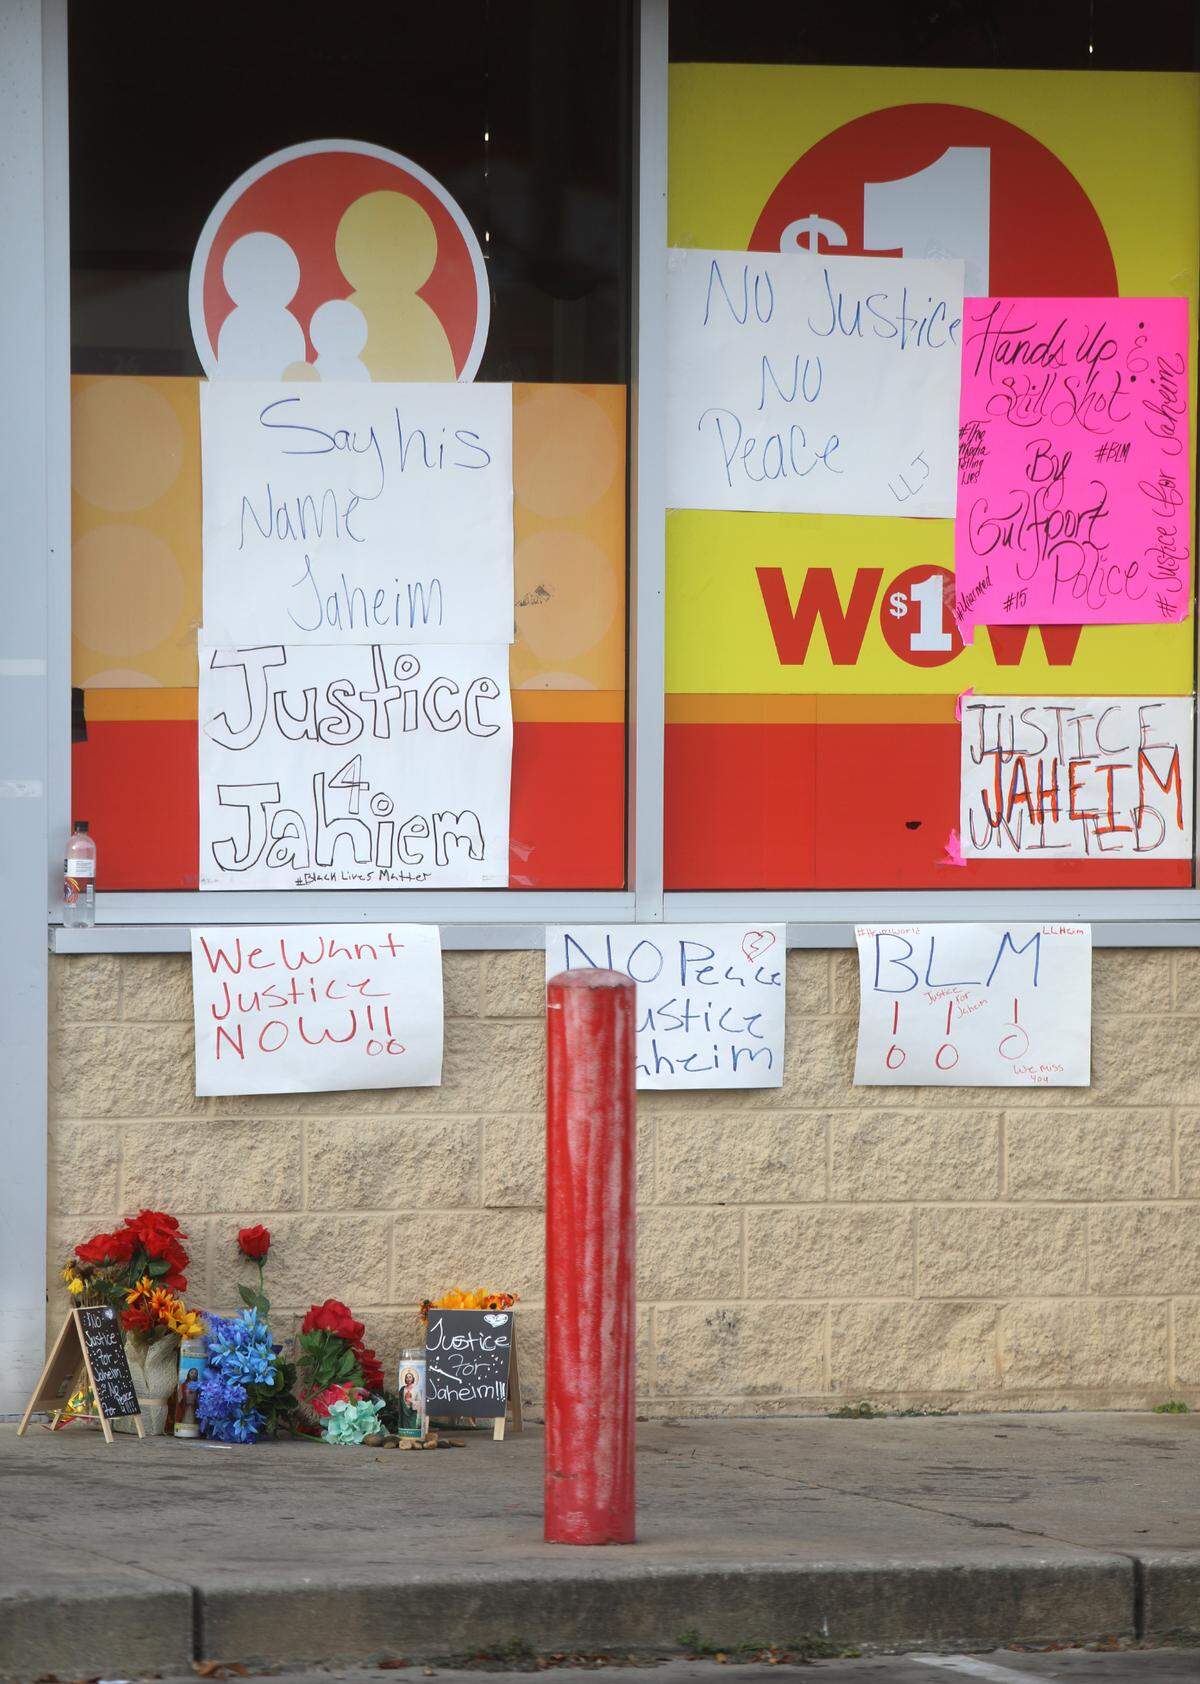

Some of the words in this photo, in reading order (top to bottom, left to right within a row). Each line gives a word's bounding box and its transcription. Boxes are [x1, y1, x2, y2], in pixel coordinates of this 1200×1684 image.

[808, 268, 961, 350] Justice
[966, 301, 1068, 386] Hands
[1076, 321, 1118, 384] Up
[1051, 371, 1131, 434] Shot
[259, 397, 384, 500] Say
[395, 407, 491, 472] his
[698, 407, 844, 488] Peace
[1026, 438, 1072, 511] By
[1094, 441, 1131, 463] #BLM
[239, 482, 366, 550] Name
[969, 480, 1110, 581] Gulfport
[287, 553, 443, 632] Jaheim
[1003, 587, 1029, 613] #15
[1047, 540, 1149, 610] Police
[889, 574, 953, 652] $1
[203, 643, 501, 751] Justice
[966, 704, 1175, 766] JUSTICE
[327, 753, 370, 815] 4
[981, 744, 1185, 835] JAHEIM
[211, 772, 485, 872] Jahiem
[969, 805, 1167, 856] UNITED
[379, 869, 432, 882] Matter
[199, 935, 276, 974] We
[873, 931, 1041, 993] BLM
[211, 977, 392, 1020] Justice
[635, 998, 764, 1039] ustice
[85, 1330, 118, 1348] Justice
[426, 1317, 511, 1351] Justice
